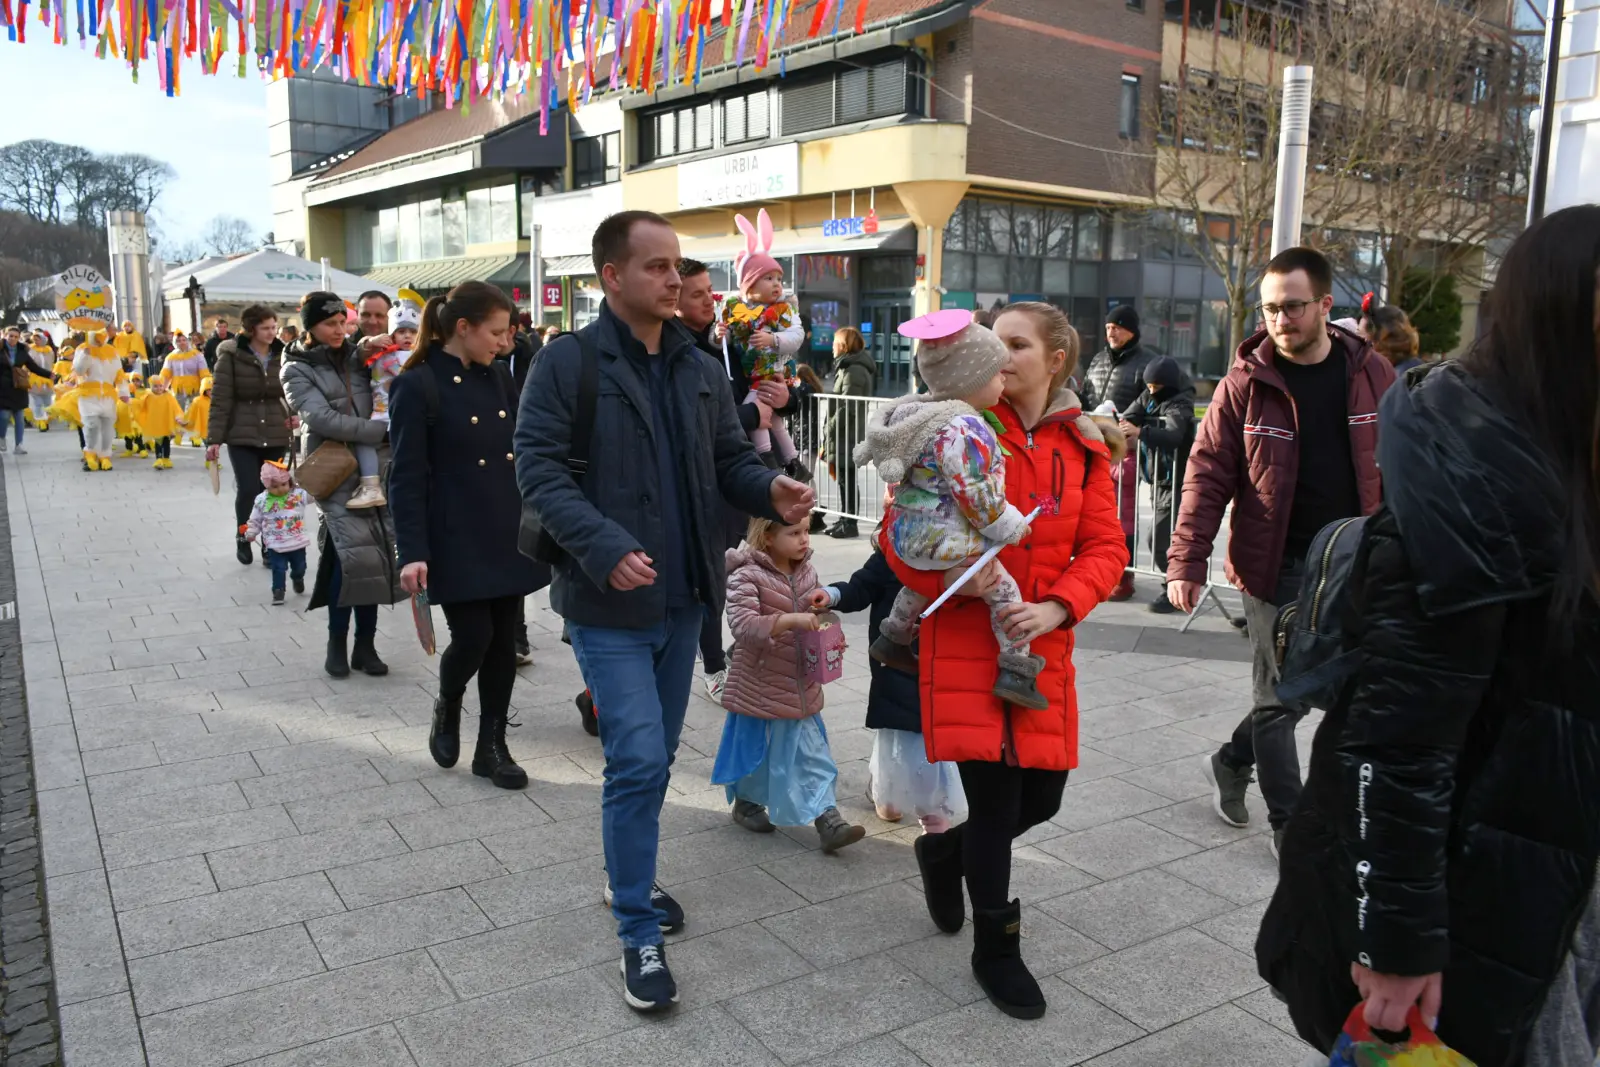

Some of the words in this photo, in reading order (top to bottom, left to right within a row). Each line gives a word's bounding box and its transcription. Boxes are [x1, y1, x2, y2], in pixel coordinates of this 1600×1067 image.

[724, 155, 759, 175] URBIA
[766, 174, 784, 193] 25
[823, 217, 863, 236] ERSTE
[61, 267, 100, 285] PILIĆI
[59, 311, 71, 321] PO
